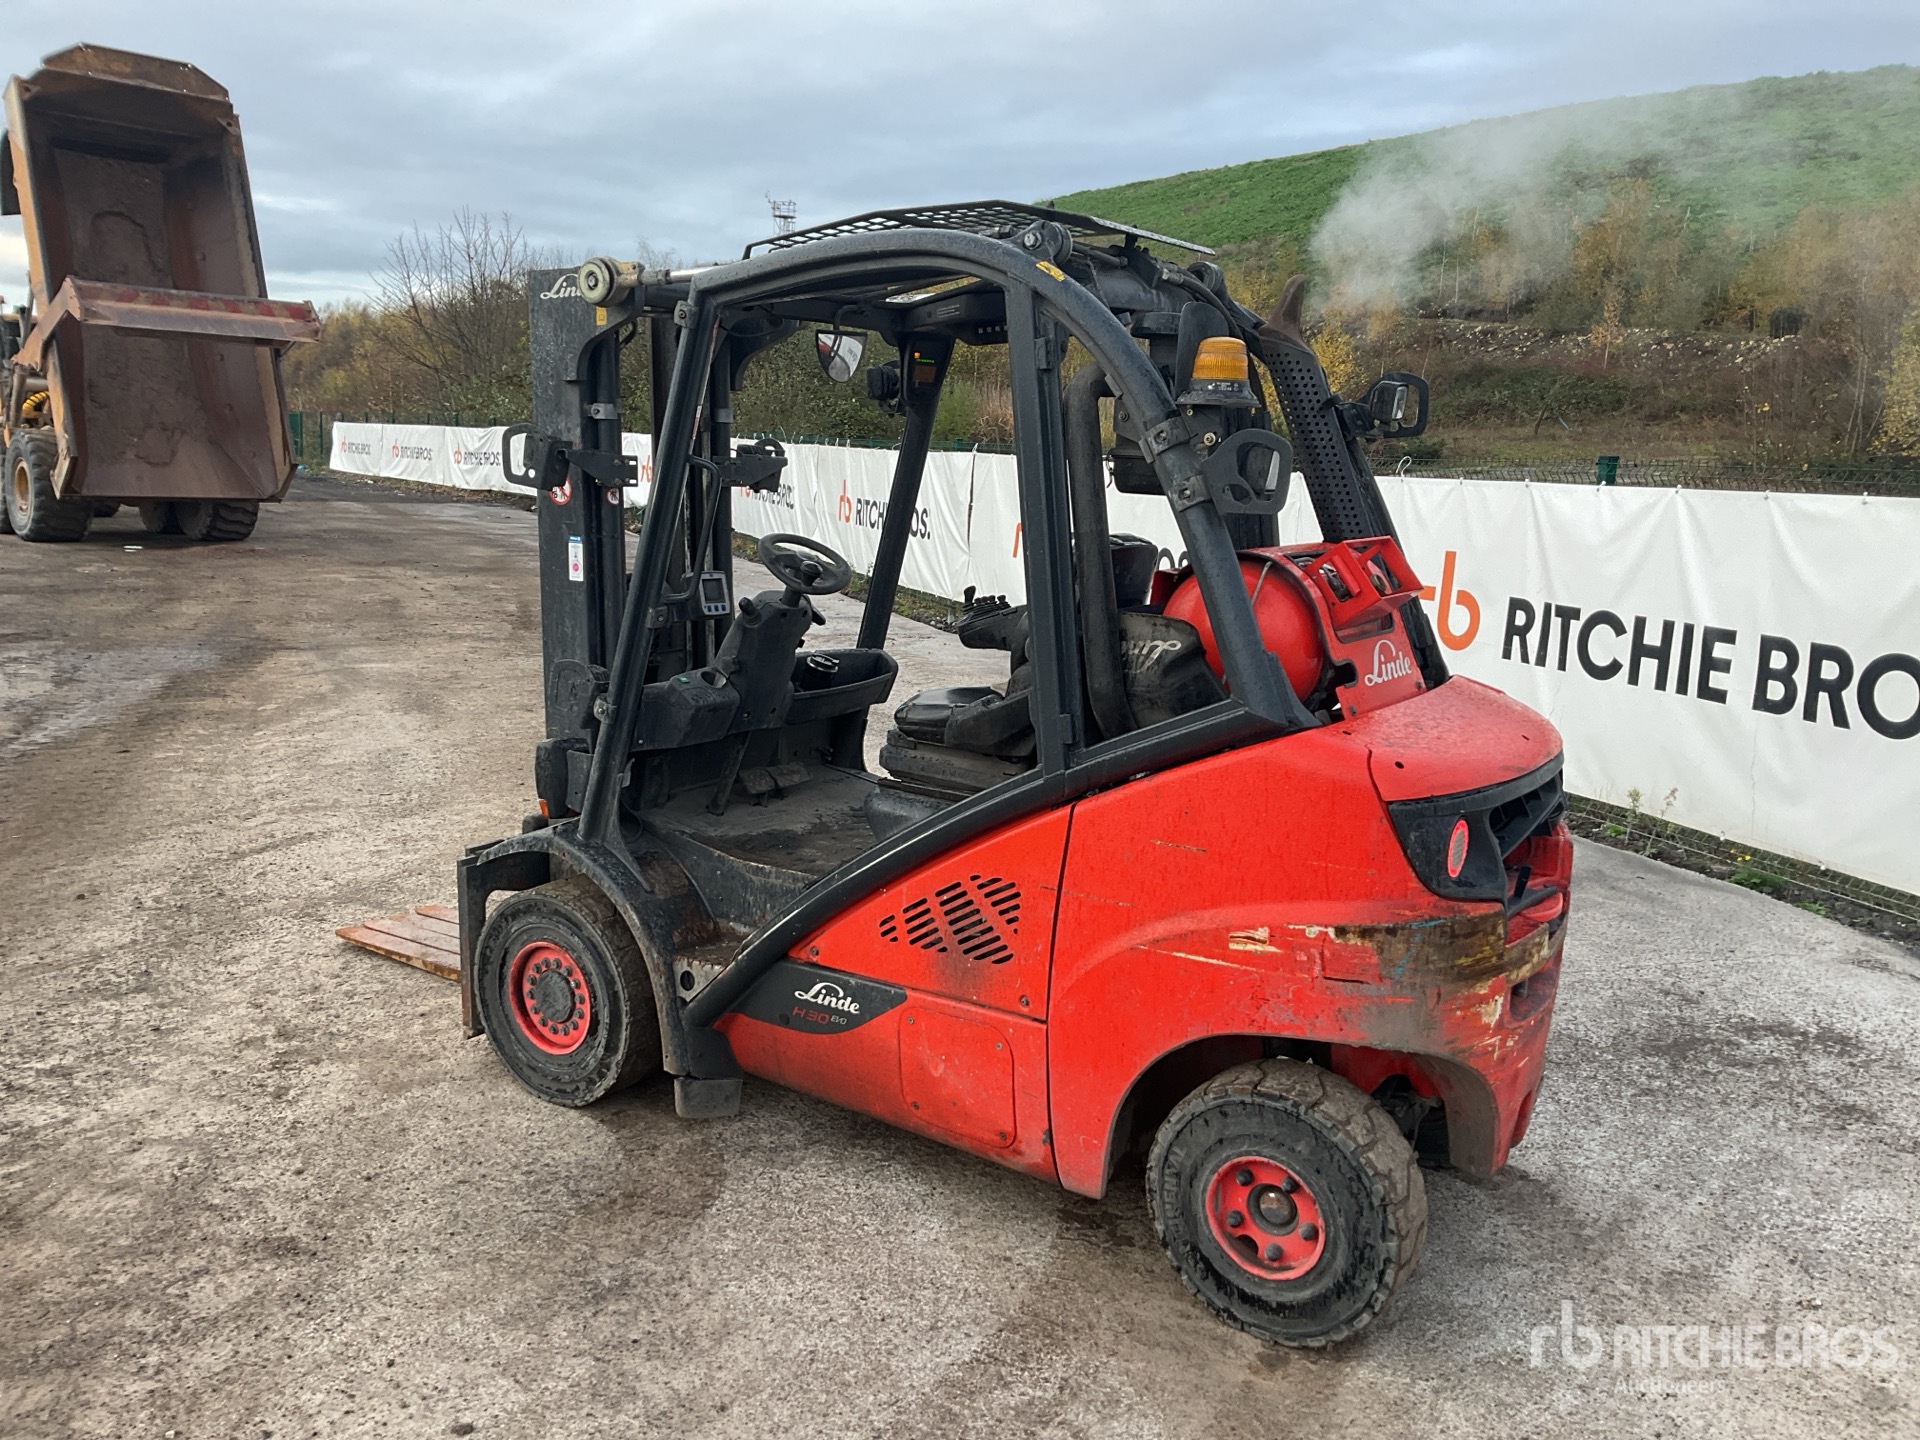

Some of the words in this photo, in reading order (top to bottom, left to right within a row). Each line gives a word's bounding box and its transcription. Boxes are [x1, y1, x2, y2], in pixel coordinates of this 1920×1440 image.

[540, 273, 580, 299] Lin
[855, 497, 889, 531] RITCH
[1364, 639, 1412, 686] Linde
[1500, 596, 1737, 706] RITCHIE
[1752, 634, 1920, 741] BRO
[794, 982, 860, 1014] Linde
